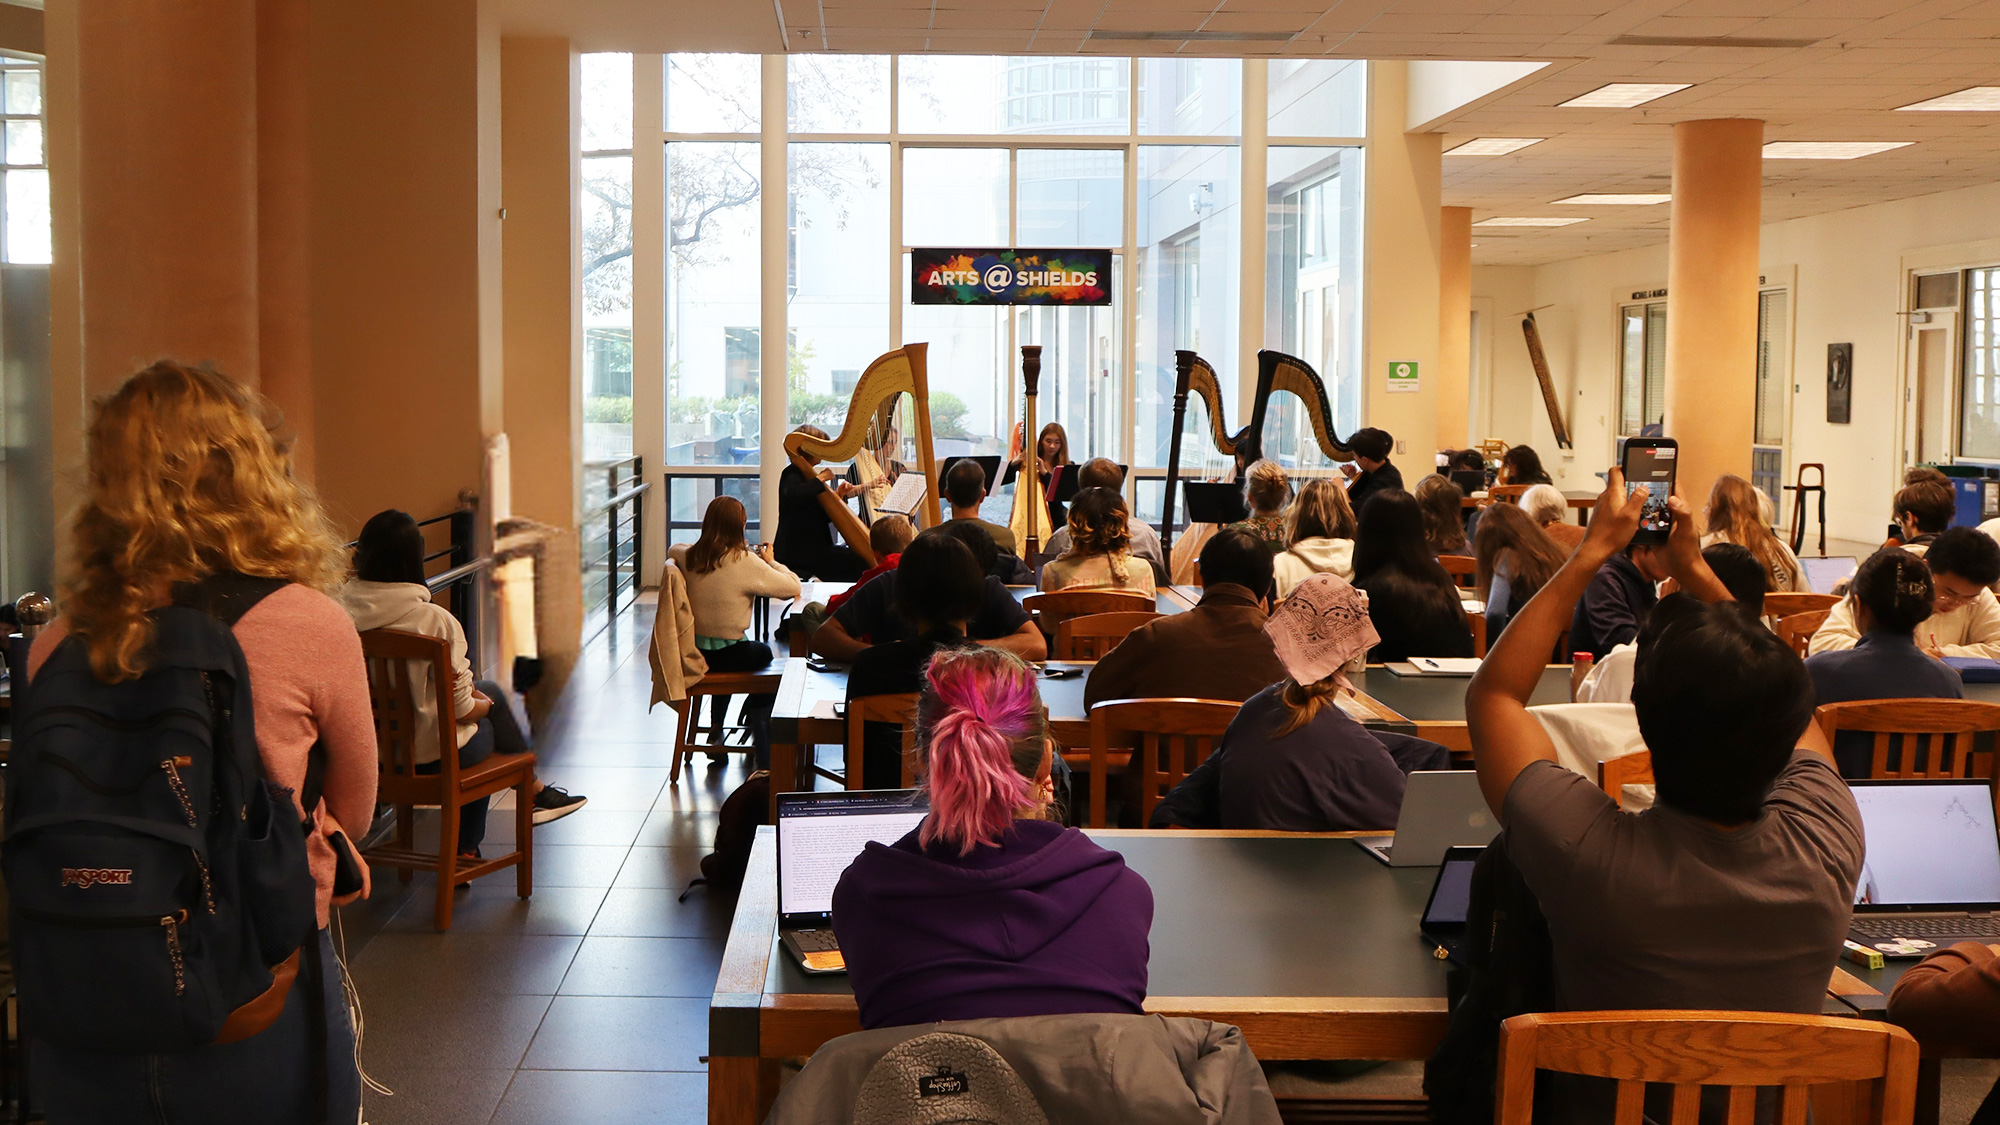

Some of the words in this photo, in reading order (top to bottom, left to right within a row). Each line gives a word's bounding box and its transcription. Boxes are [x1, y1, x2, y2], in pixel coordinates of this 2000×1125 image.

[928, 270, 979, 286] ARTS
[984, 264, 1013, 293] @
[1016, 271, 1098, 287] SHIELDS
